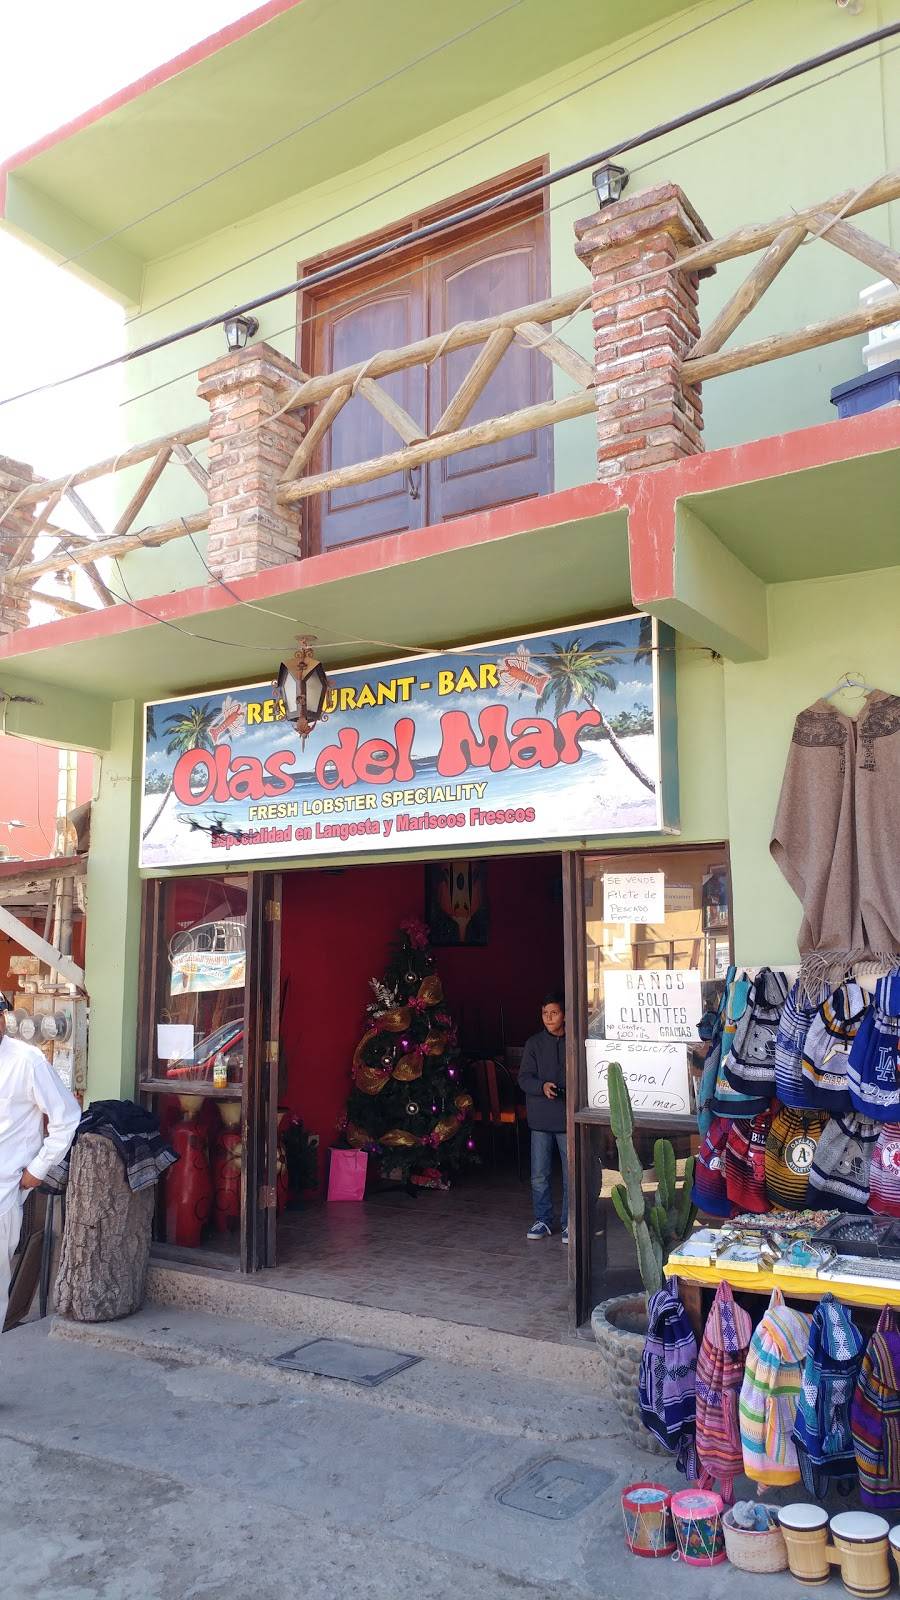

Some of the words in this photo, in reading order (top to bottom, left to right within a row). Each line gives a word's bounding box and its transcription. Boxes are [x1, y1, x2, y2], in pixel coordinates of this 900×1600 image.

[247, 676, 417, 726] RESURANT
[438, 663, 500, 697] BAR
[172, 744, 296, 806] Olas
[315, 718, 415, 790] del
[436, 704, 602, 777] Mar
[249, 802, 298, 821] FRESH
[303, 795, 377, 816] LOBSTER
[380, 782, 488, 808] SPECIALITY
[295, 827, 312, 841] en
[315, 818, 380, 841] Langosta
[383, 818, 393, 837] y
[396, 810, 466, 832] Mariscos
[470, 807, 536, 827] Frescos
[626, 972, 685, 990] BAÑOS
[637, 993, 669, 1006] SOLO
[620, 1008, 687, 1024] CLIENTES
[659, 1026, 692, 1038] GRACIAS
